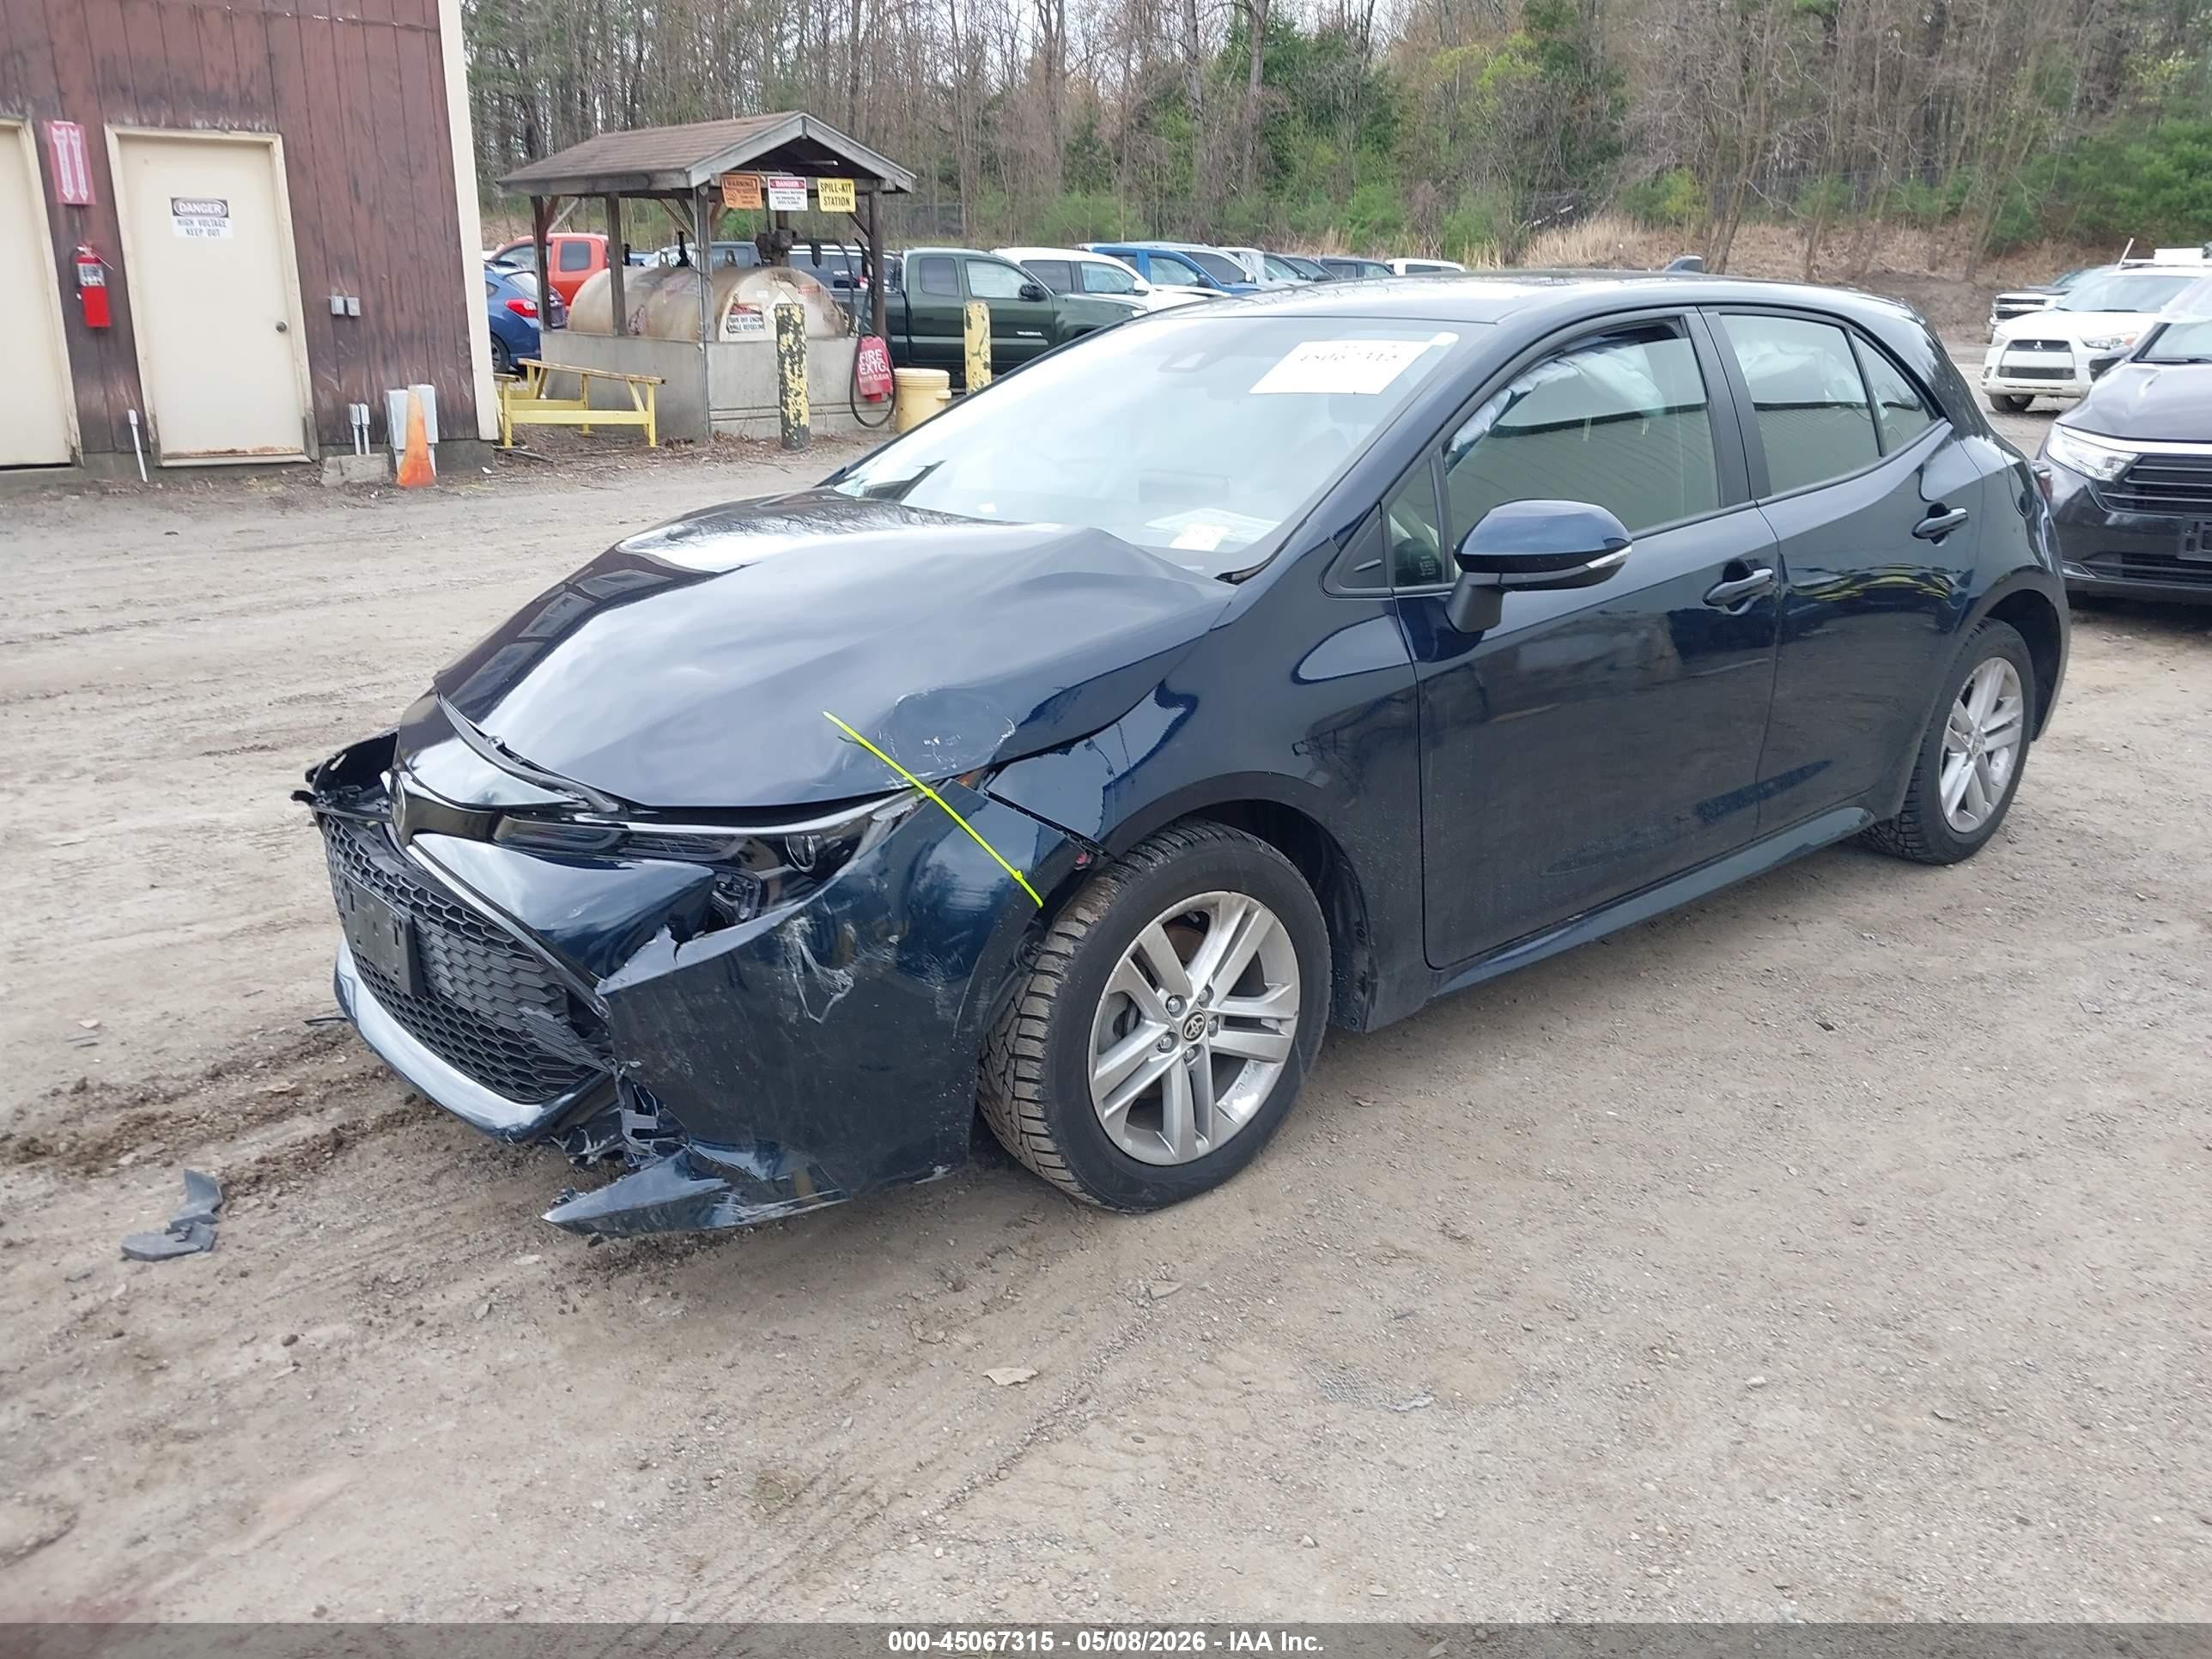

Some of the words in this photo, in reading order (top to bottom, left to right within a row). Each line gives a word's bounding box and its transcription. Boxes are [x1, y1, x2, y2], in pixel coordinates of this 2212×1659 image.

[820, 182, 852, 193] SPILL-KIT
[823, 197, 850, 206] STATION
[179, 202, 222, 214] DANGER
[198, 219, 227, 228] VOLTAGE
[185, 228, 203, 236] KEEP
[207, 228, 220, 237] OUT
[860, 349, 883, 364] FIRE
